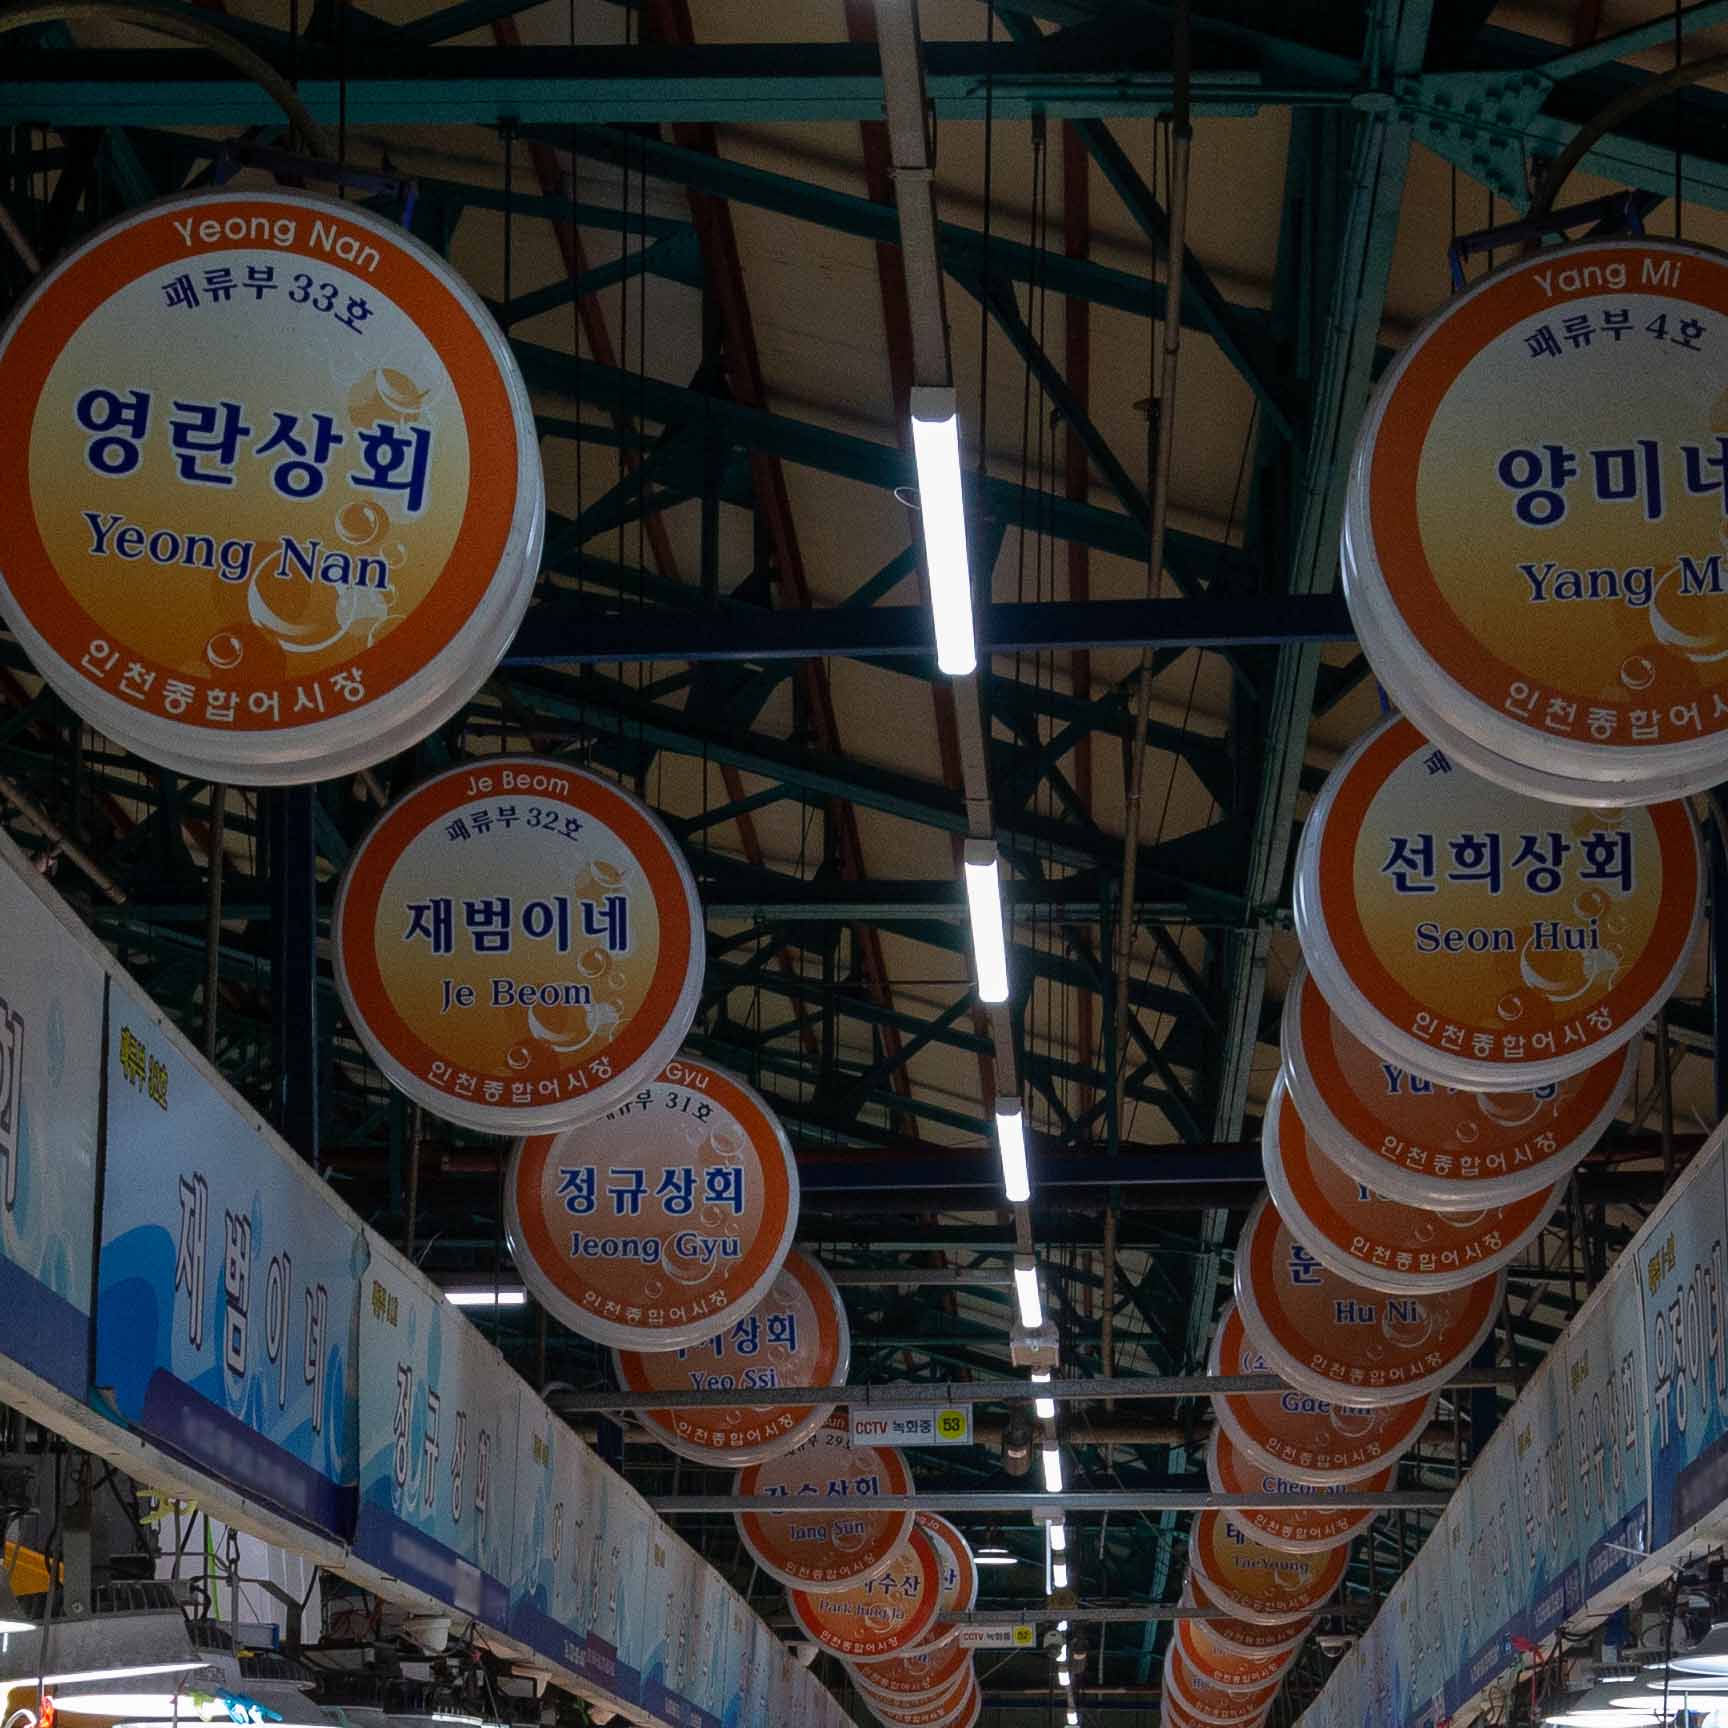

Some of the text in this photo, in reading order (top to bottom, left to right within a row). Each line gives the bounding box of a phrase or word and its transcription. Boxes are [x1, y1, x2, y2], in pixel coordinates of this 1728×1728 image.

[173, 212, 380, 272] Yeong Nan
[161, 265, 375, 334] 패류부 33호
[1534, 257, 1681, 299] Yang Mi
[1527, 308, 1708, 359] 패류부 4호
[76, 388, 432, 513] 영란상회
[84, 511, 390, 589] Yeong Nan
[1519, 561, 1654, 606] Yang
[80, 638, 366, 722] 인천종합어시장
[466, 770, 569, 797] Je Beom
[444, 804, 585, 842] 패류부 32호
[1381, 832, 1634, 894] 선희상회
[404, 896, 629, 954] 재범이네
[1416, 918, 1600, 953] Seon Hui
[439, 979, 592, 1014] Je Beom
[1412, 1005, 1614, 1060] 인천종합어시장
[427, 1056, 614, 1104] 인천종합어시장
[664, 1089, 714, 1125] 31호
[1379, 1131, 1557, 1177] 인천종합어시장
[558, 1167, 744, 1215] 정규상회
[570, 1231, 740, 1263] Jeong Gyu
[1350, 1231, 1502, 1272] 인천종합어시장
[175, 1170, 328, 1435] 재범이네
[581, 1288, 729, 1325] 인천종합어시장
[1337, 1298, 1417, 1324] Hu Ni
[689, 1367, 778, 1391] Yeo Ssi
[1312, 1353, 1441, 1385] 인천종합어시장
[680, 1413, 794, 1447] 인천종합어시장
[855, 1418, 960, 1435] CCTV 녹화중 53
